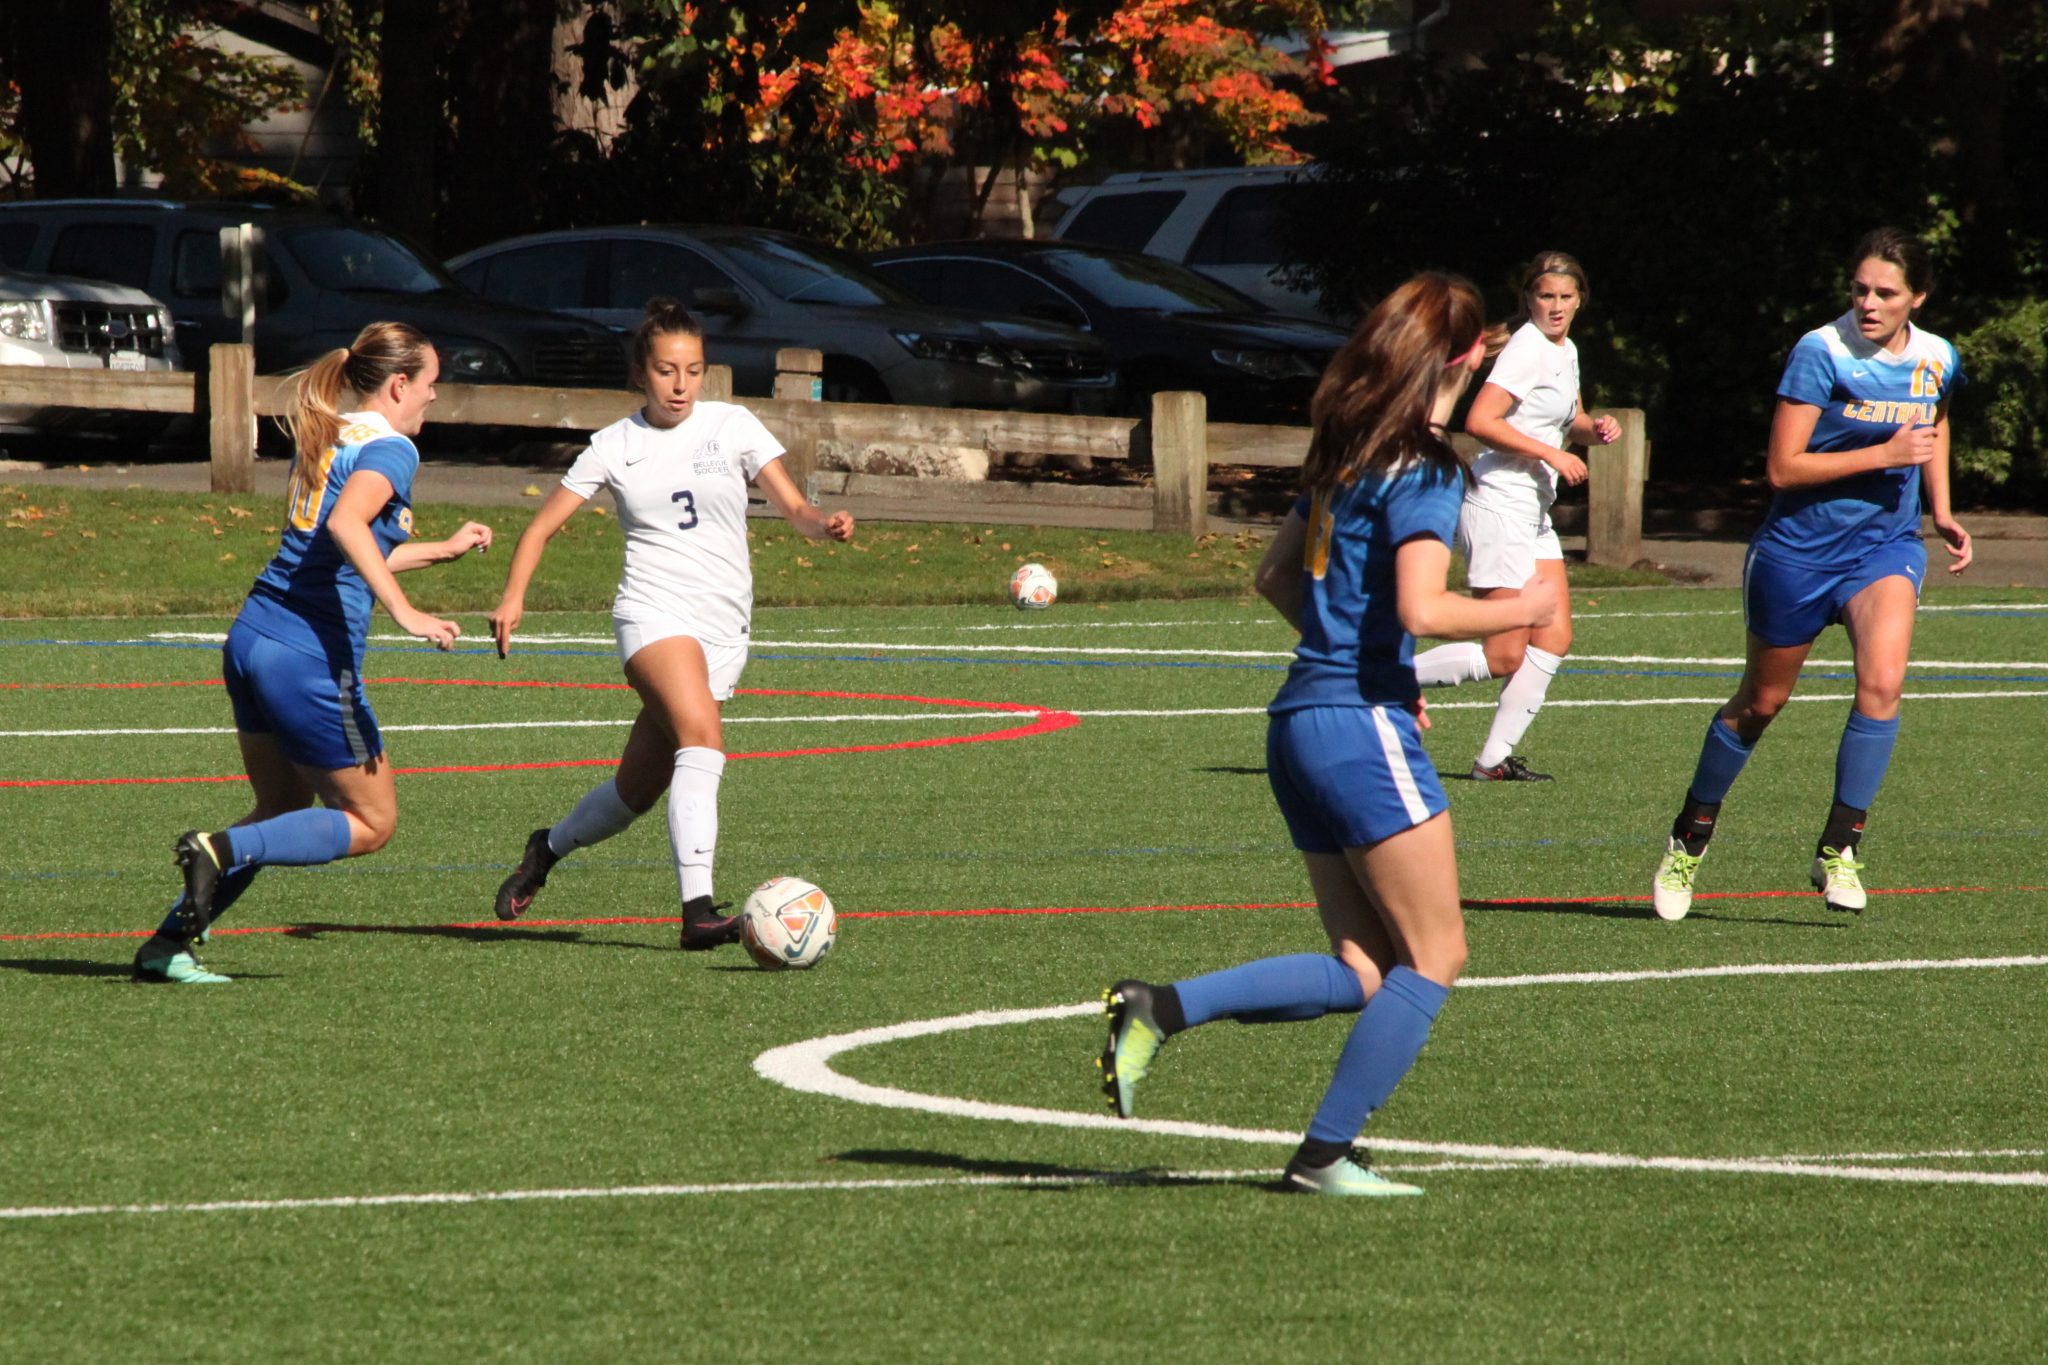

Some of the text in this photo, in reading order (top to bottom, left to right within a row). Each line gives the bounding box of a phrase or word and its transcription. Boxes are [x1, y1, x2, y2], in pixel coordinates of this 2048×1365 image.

[693, 460, 728, 469] BELLEVUE
[694, 466, 729, 475] SOCCER
[671, 489, 699, 530] 3
